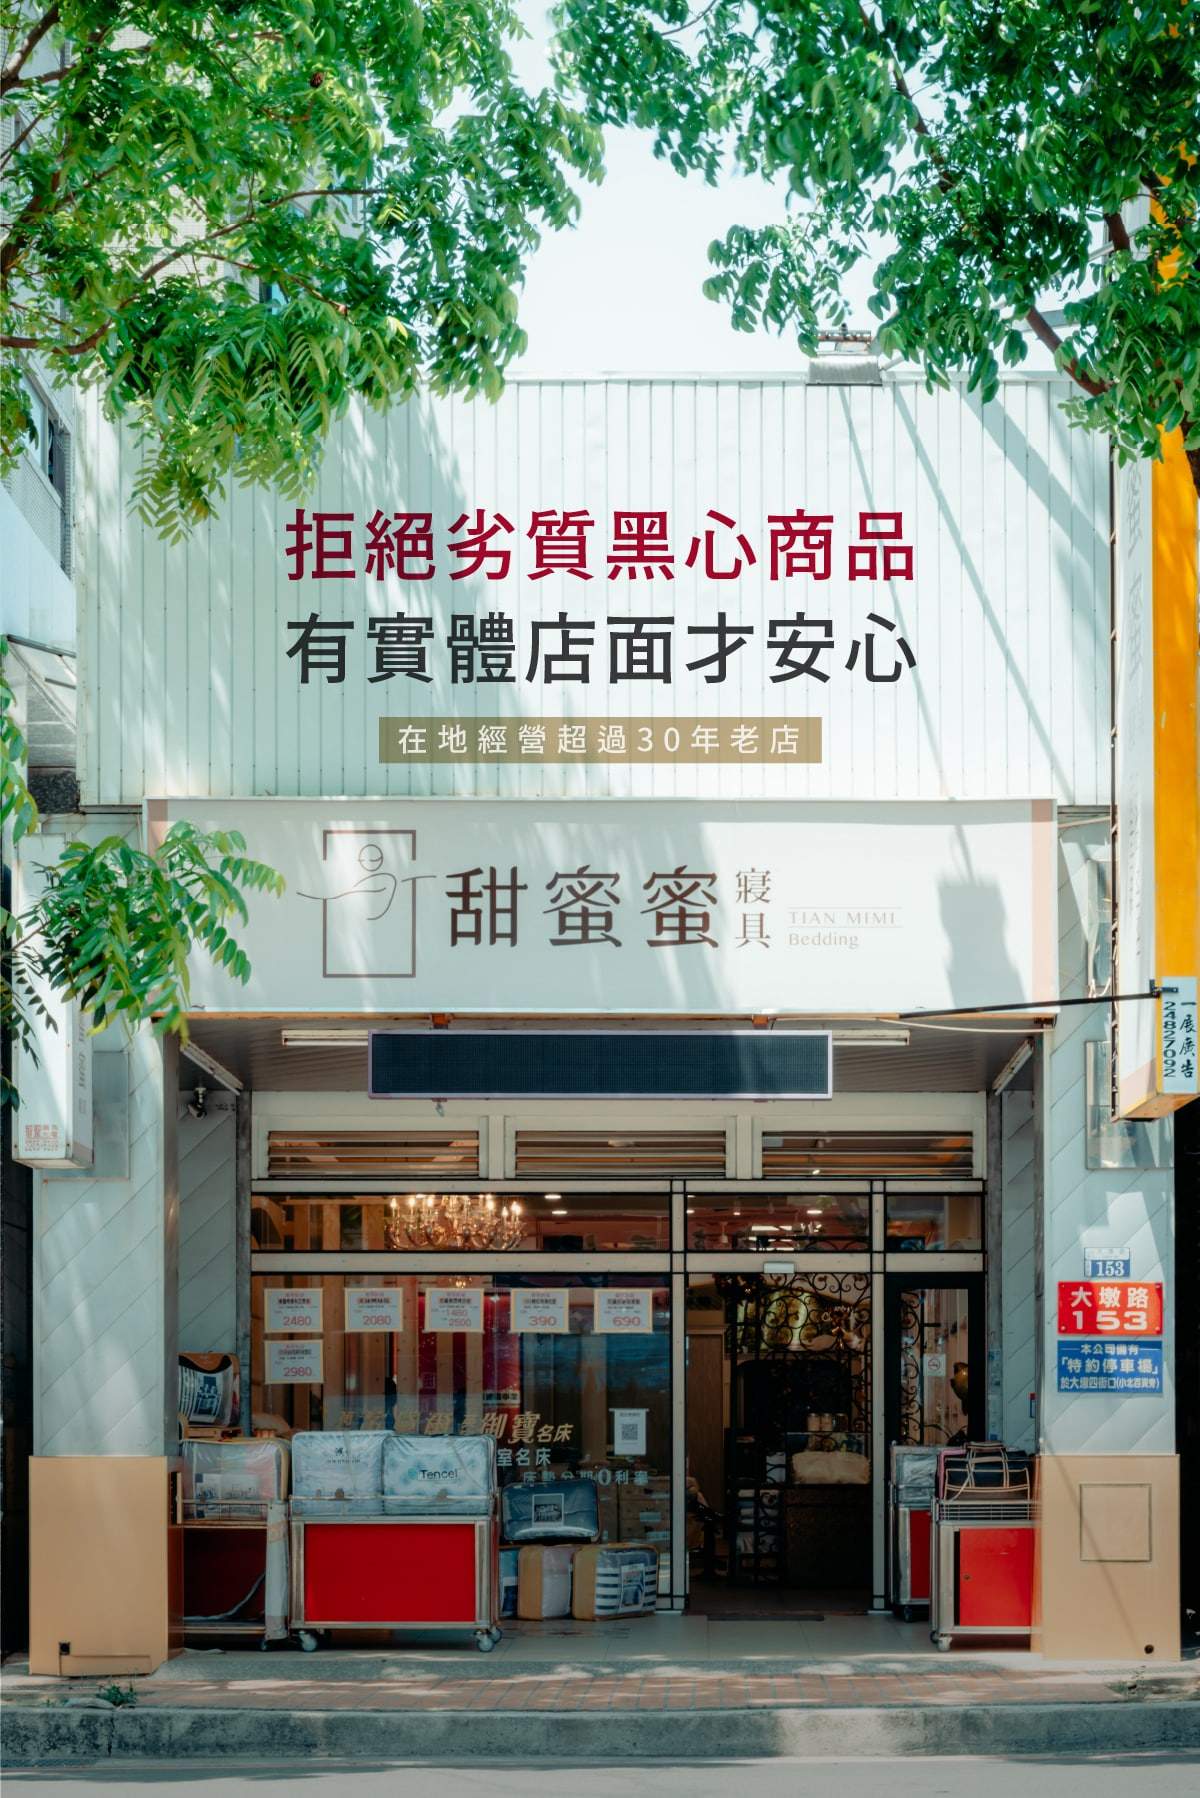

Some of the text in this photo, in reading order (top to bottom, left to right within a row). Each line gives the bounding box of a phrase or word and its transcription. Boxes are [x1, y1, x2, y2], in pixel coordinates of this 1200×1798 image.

[445, 864, 720, 948] 甜蜜蜜
[735, 867, 772, 949] 寢具
[788, 911, 896, 924] TIAN MIMI
[788, 931, 859, 950] Bedding
[1163, 1001, 1177, 1078] 24827092
[1096, 1260, 1125, 1277] 153
[1071, 1286, 1149, 1309] 大墩路
[283, 1315, 312, 1326] 2480
[363, 1315, 392, 1326] 2080
[528, 1315, 557, 1327] 390
[613, 1315, 641, 1327] 690
[1072, 1311, 1148, 1330] 153
[283, 1366, 312, 1377] 2980
[420, 1468, 459, 1480] Tencel
